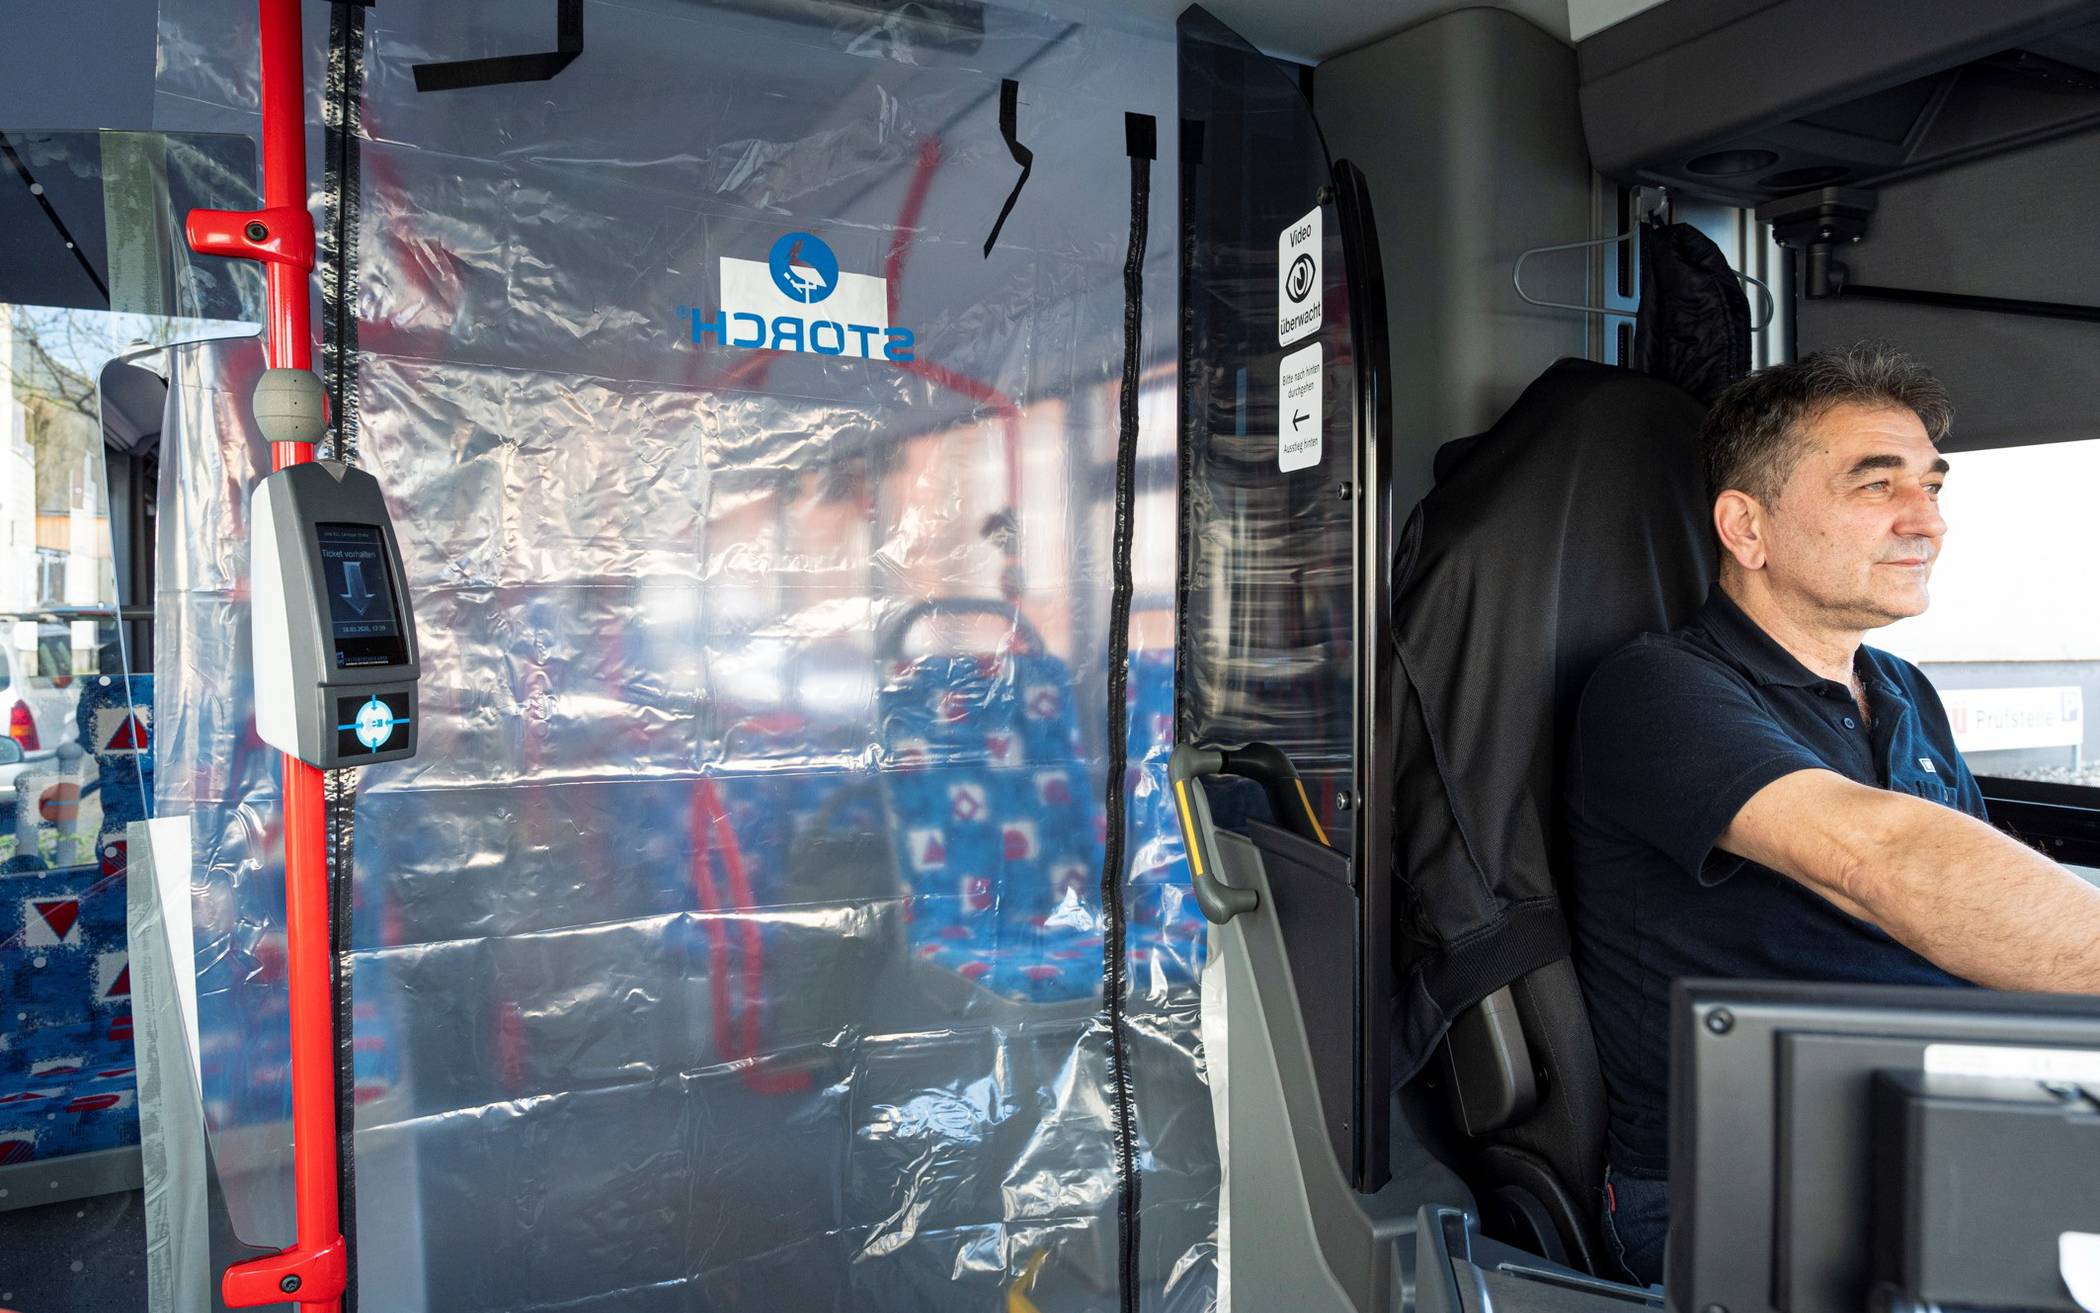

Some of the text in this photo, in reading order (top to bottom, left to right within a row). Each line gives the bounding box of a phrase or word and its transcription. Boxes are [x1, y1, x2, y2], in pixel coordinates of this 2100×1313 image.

[1289, 224, 1312, 248] Video
[1280, 301, 1321, 335] überwacht
[1282, 364, 1320, 386] Bitte nach hinten
[1287, 382, 1314, 398] durchgehen
[1283, 437, 1318, 453] Ausstieg hinten
[322, 549, 376, 559] Ticket vorhalten
